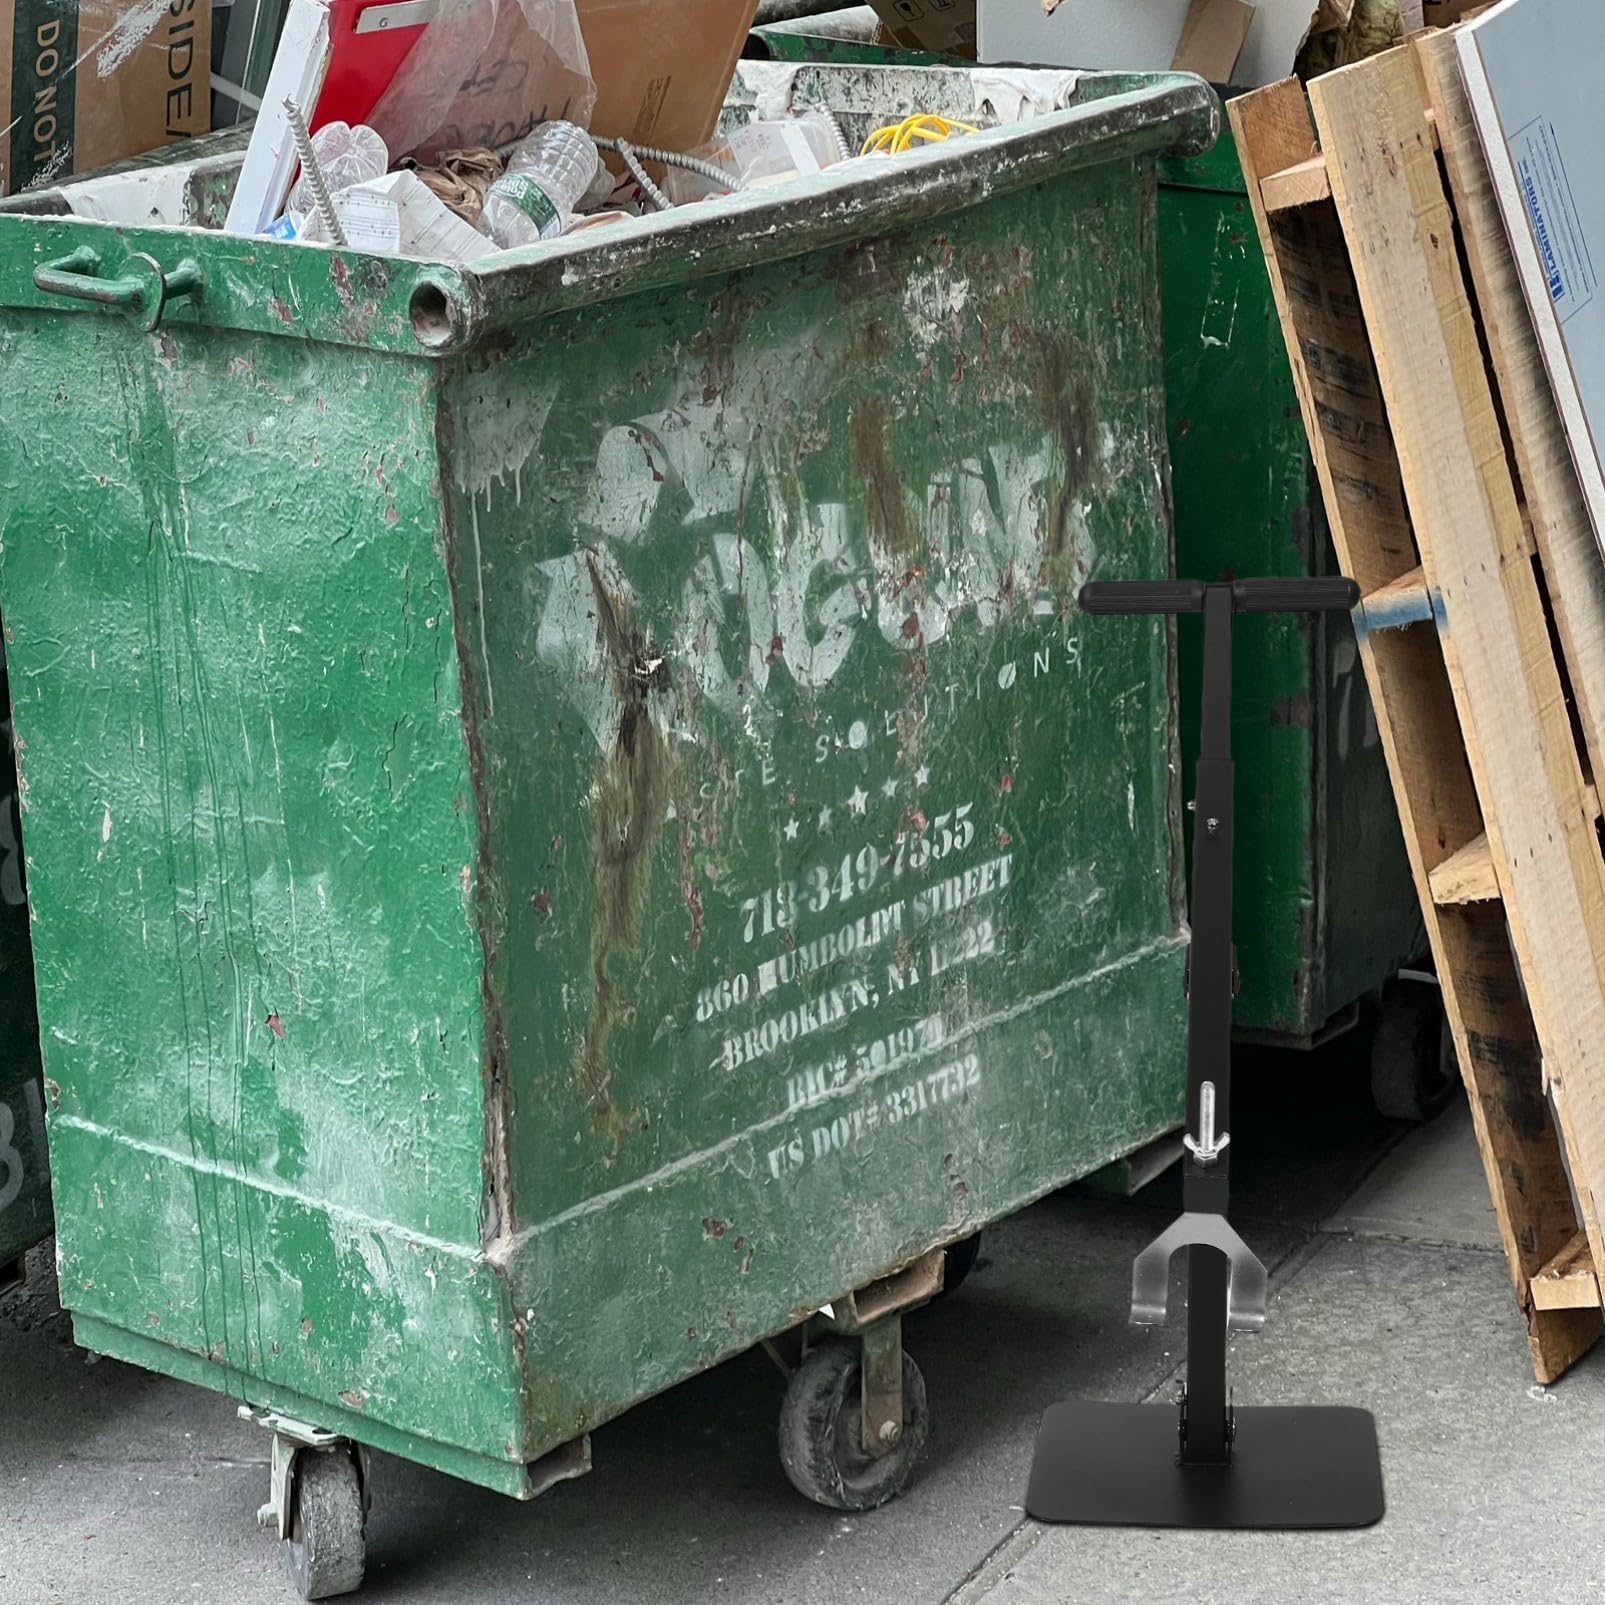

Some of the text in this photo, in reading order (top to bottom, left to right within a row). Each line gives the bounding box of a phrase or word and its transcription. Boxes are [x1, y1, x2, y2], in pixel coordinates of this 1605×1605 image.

[33, 19, 60, 161] DO NOT
[1526, 176, 1558, 271] LAMINATORS
[696, 973, 749, 1022] 860
[913, 853, 1012, 928] STREET
[768, 1128, 804, 1179] US
